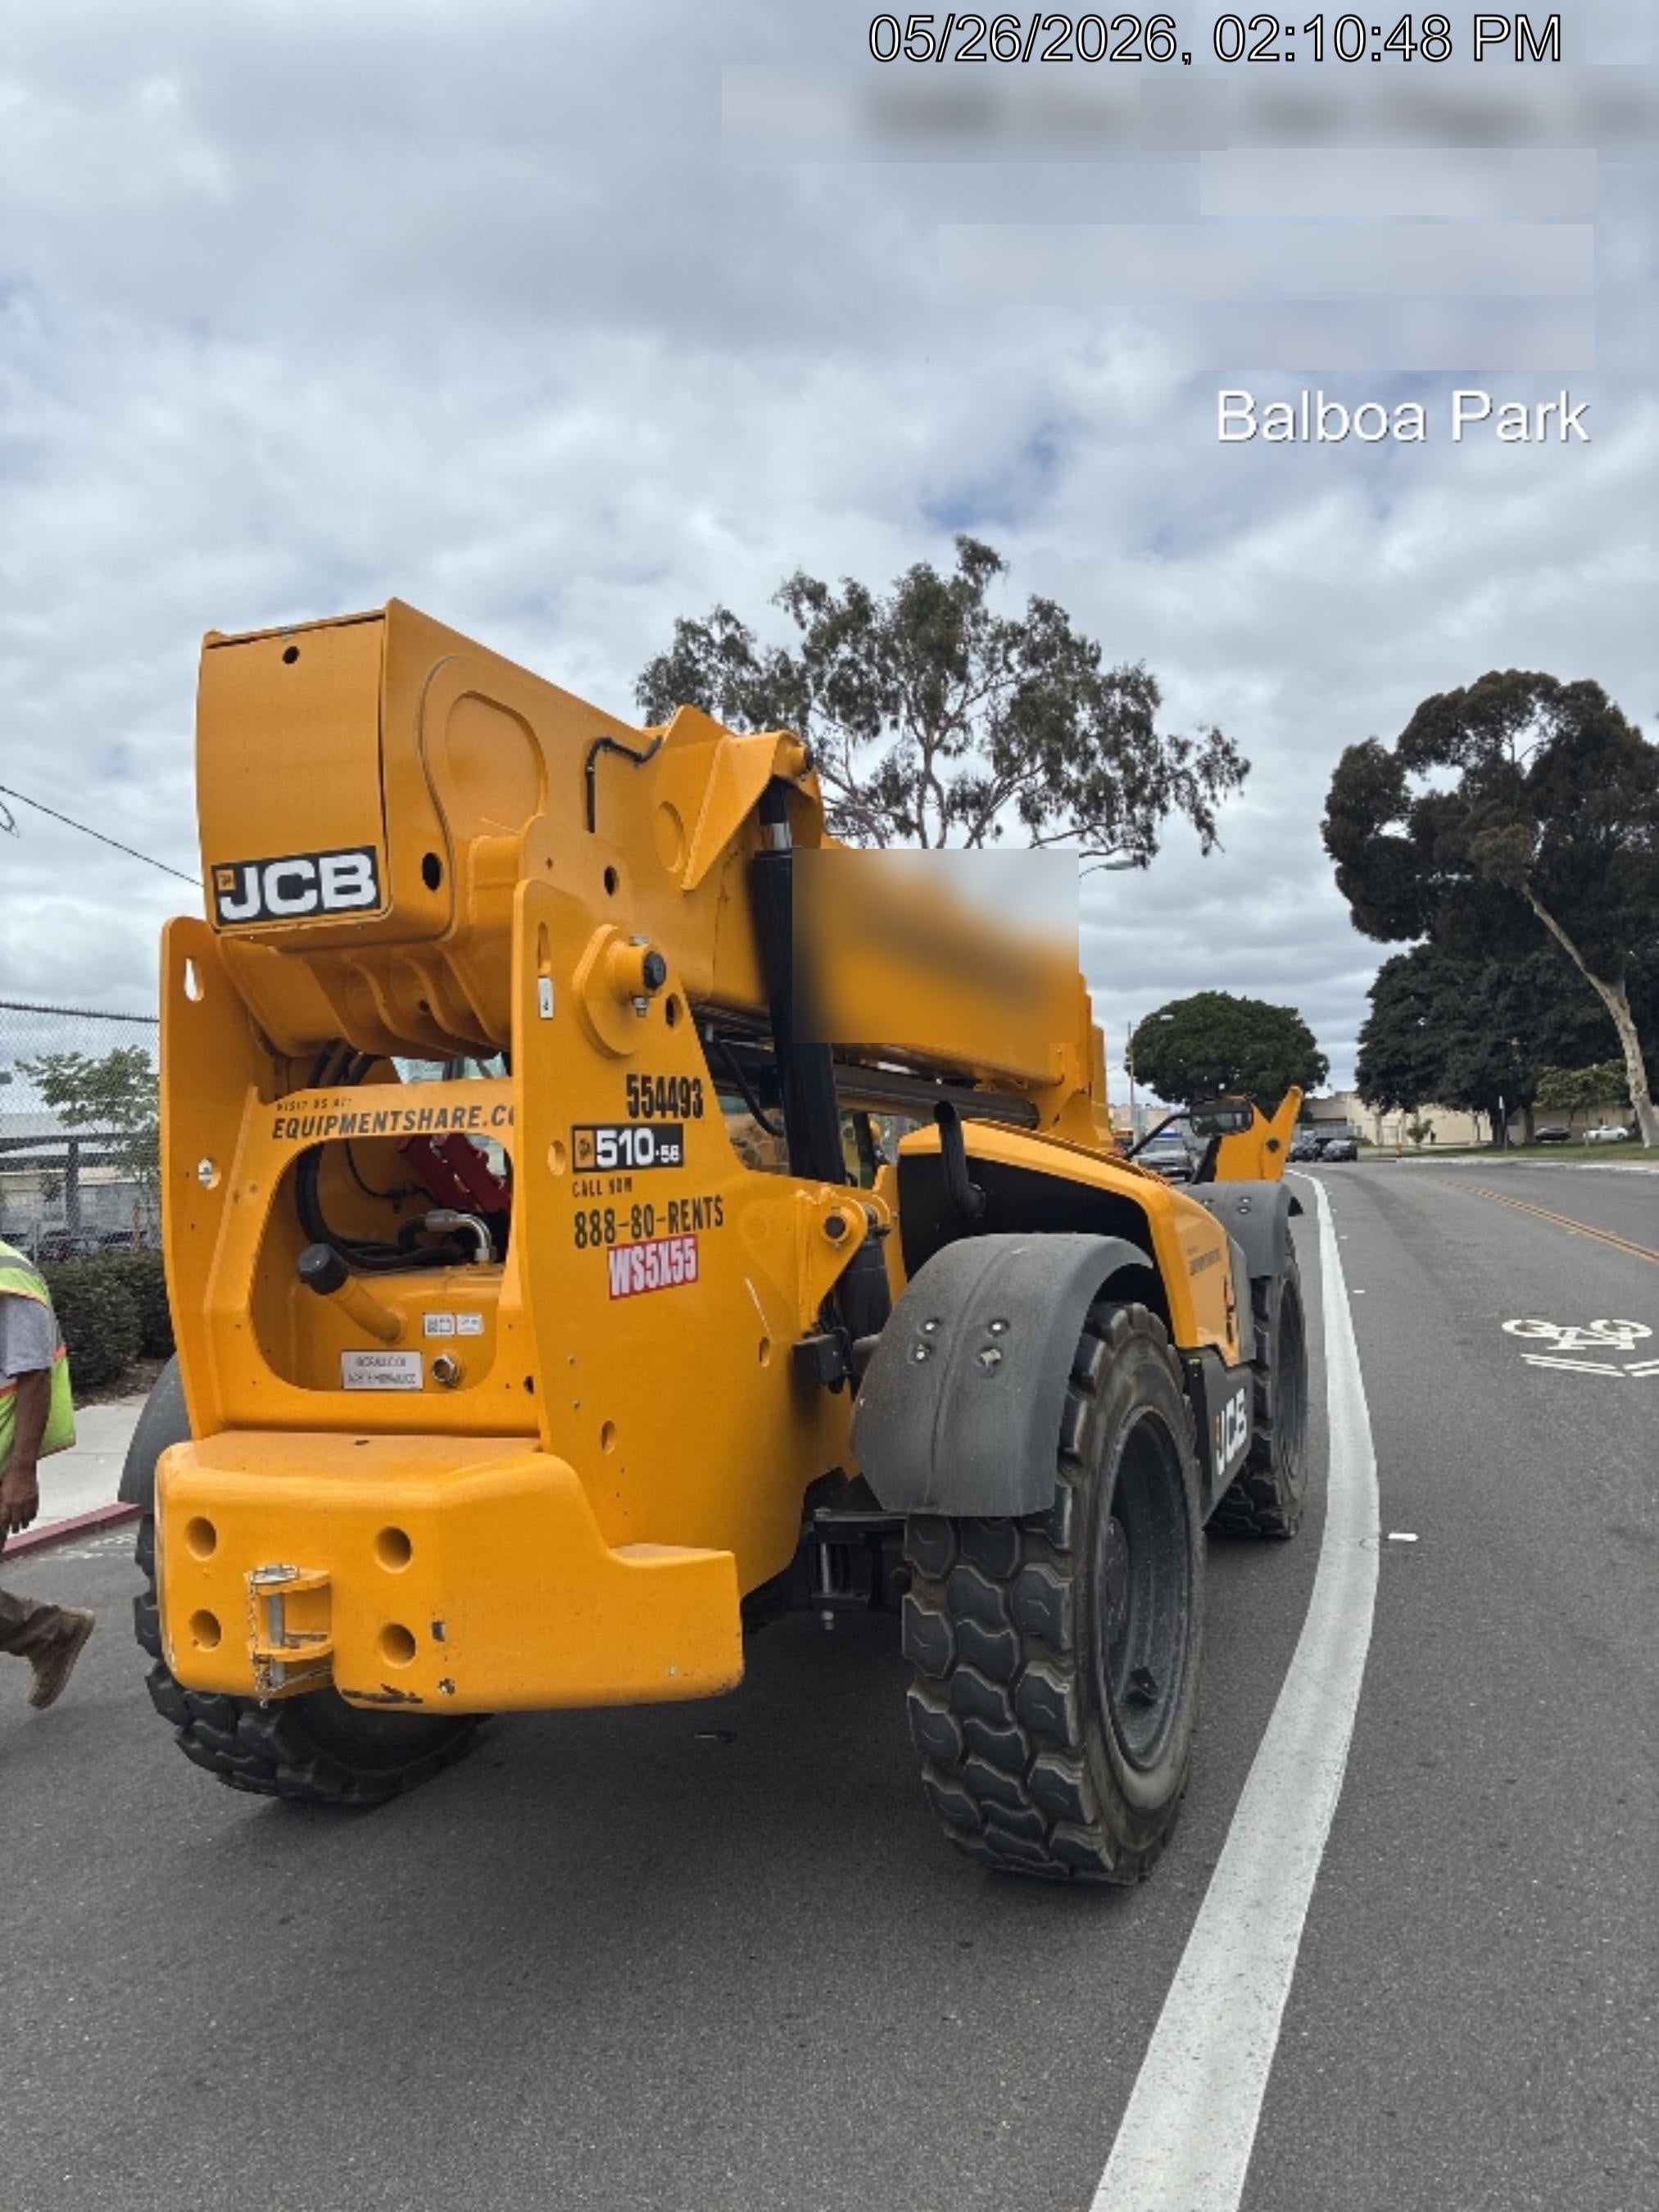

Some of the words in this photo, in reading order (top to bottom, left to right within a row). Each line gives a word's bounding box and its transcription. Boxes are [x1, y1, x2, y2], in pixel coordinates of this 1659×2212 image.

[219, 854, 377, 920] JCB
[626, 1073, 705, 1119] 554493
[573, 1179, 603, 1198] CALL
[574, 1194, 723, 1249] 888-80-RENTS
[1217, 1388, 1247, 1475] JCB
